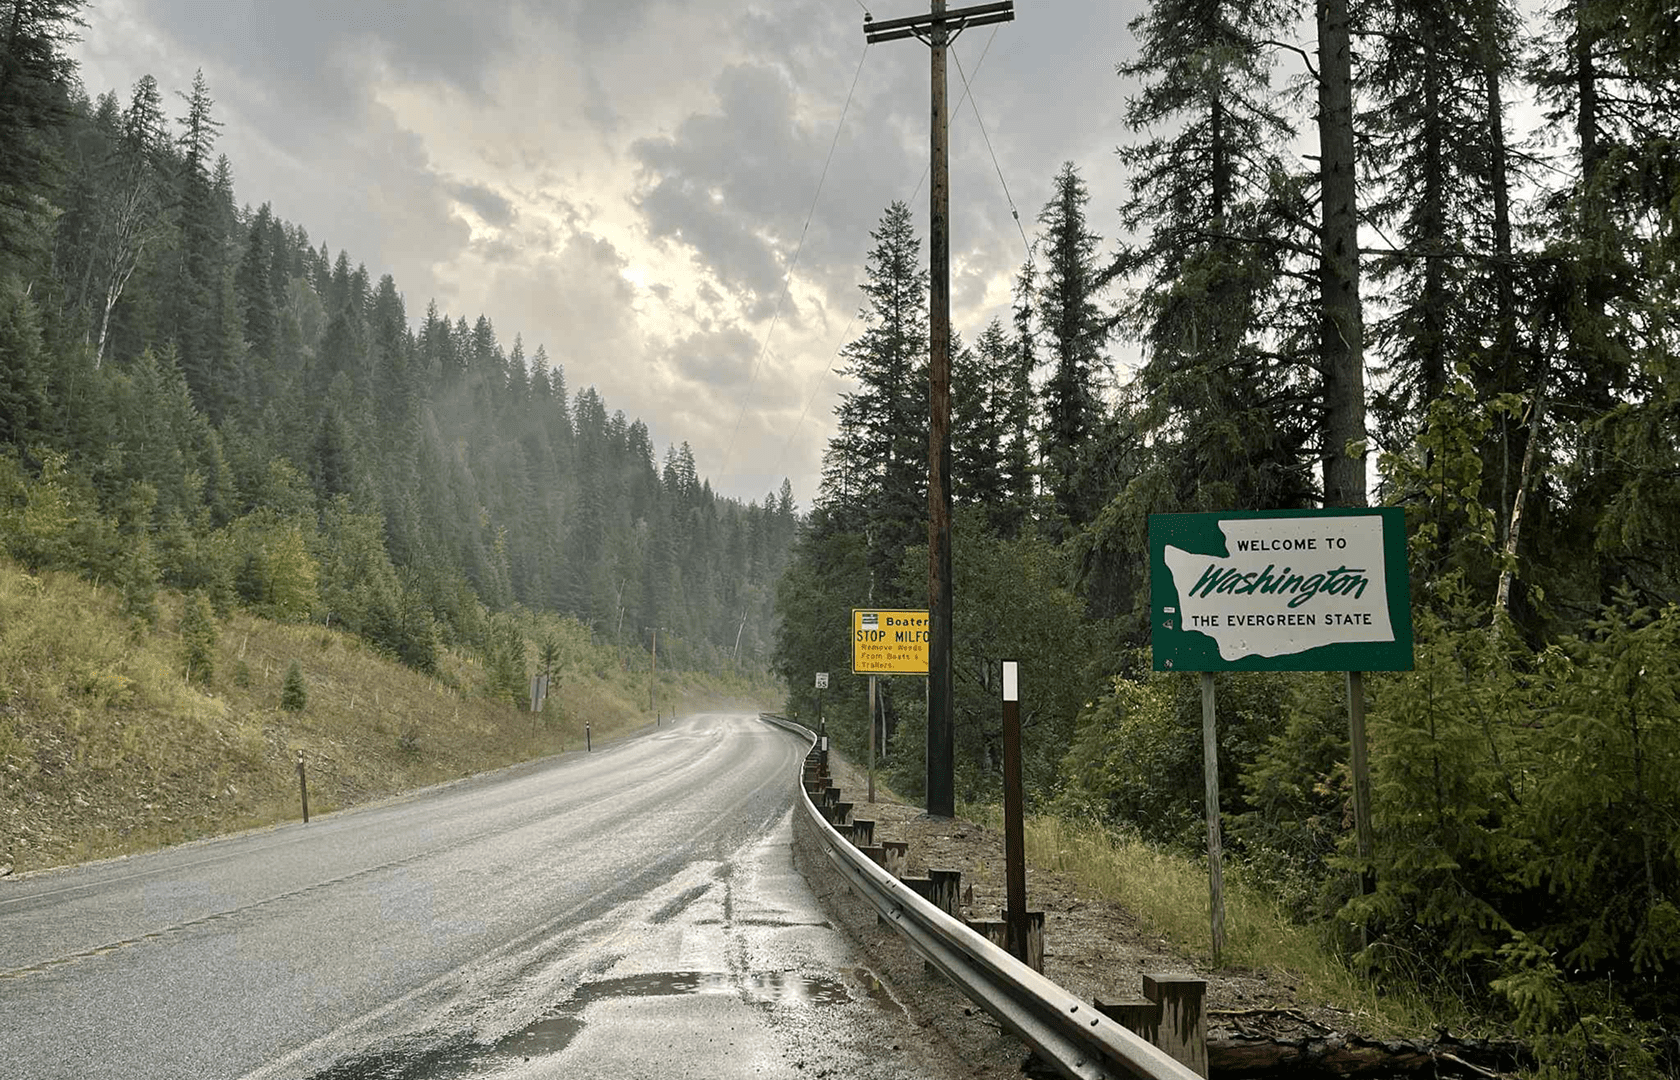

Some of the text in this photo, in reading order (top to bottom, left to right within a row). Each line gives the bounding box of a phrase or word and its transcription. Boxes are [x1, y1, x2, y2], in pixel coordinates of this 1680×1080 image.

[1237, 537, 1347, 551] WELCOME TO
[1188, 564, 1369, 608] Washington
[1191, 613, 1372, 627] THE EVERGREEN STATE
[856, 630, 886, 642] STOP
